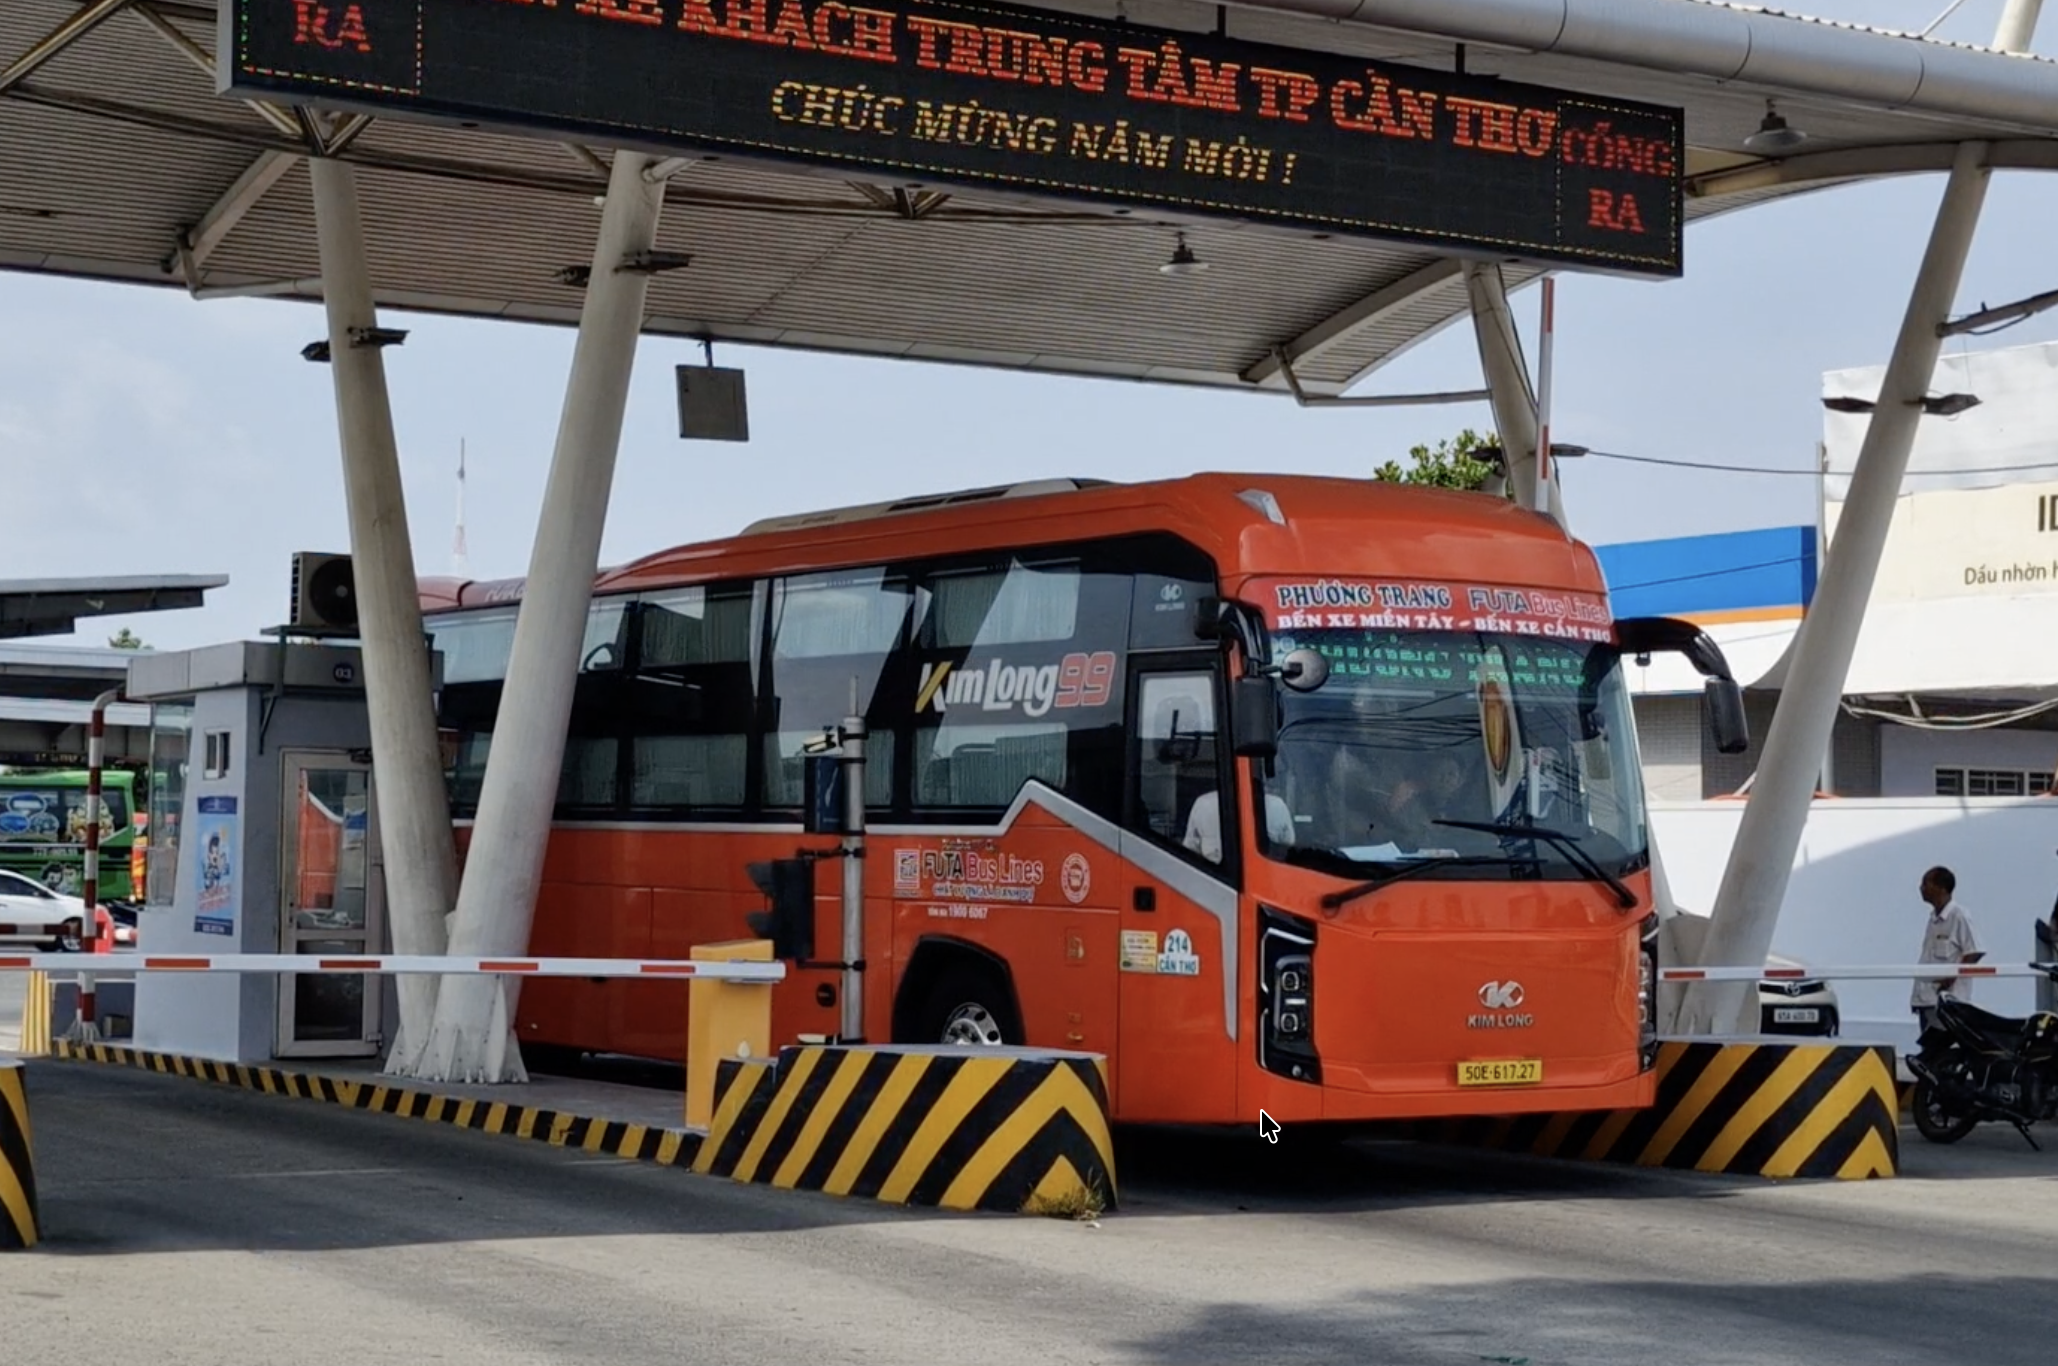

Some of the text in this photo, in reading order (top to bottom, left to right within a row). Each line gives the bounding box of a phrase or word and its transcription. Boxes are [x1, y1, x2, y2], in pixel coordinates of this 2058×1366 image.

[907, 15, 1108, 93] TRUNG
[1118, 39, 1241, 112] TÂM
[1251, 66, 1318, 121] TP
[1331, 68, 1438, 140] CẦN
[1445, 96, 1558, 156] THƠ
[772, 81, 905, 136] CHÚC
[911, 99, 1058, 154] MỪNG
[1070, 120, 1174, 168] NĂM
[1184, 135, 1272, 181] MỚI
[1587, 188, 1645, 232] RA
[1964, 562, 1997, 585] Dấu
[2002, 561, 2047, 582] nhờn
[1276, 579, 1373, 609] PHƯƠNG
[1376, 583, 1452, 610] TRANG
[1468, 587, 1531, 615] FUTA
[1277, 608, 1322, 629] BẾN
[1326, 613, 1356, 628] XE
[1414, 612, 1454, 630] TÂY
[1474, 612, 1512, 632] BẾN
[1515, 619, 1541, 634] XE
[923, 850, 965, 881] FUTA
[966, 852, 997, 882] Bus
[999, 853, 1044, 885] Lines
[1167, 935, 1188, 953] 214
[1467, 1013, 1533, 1028] KIM LONG
